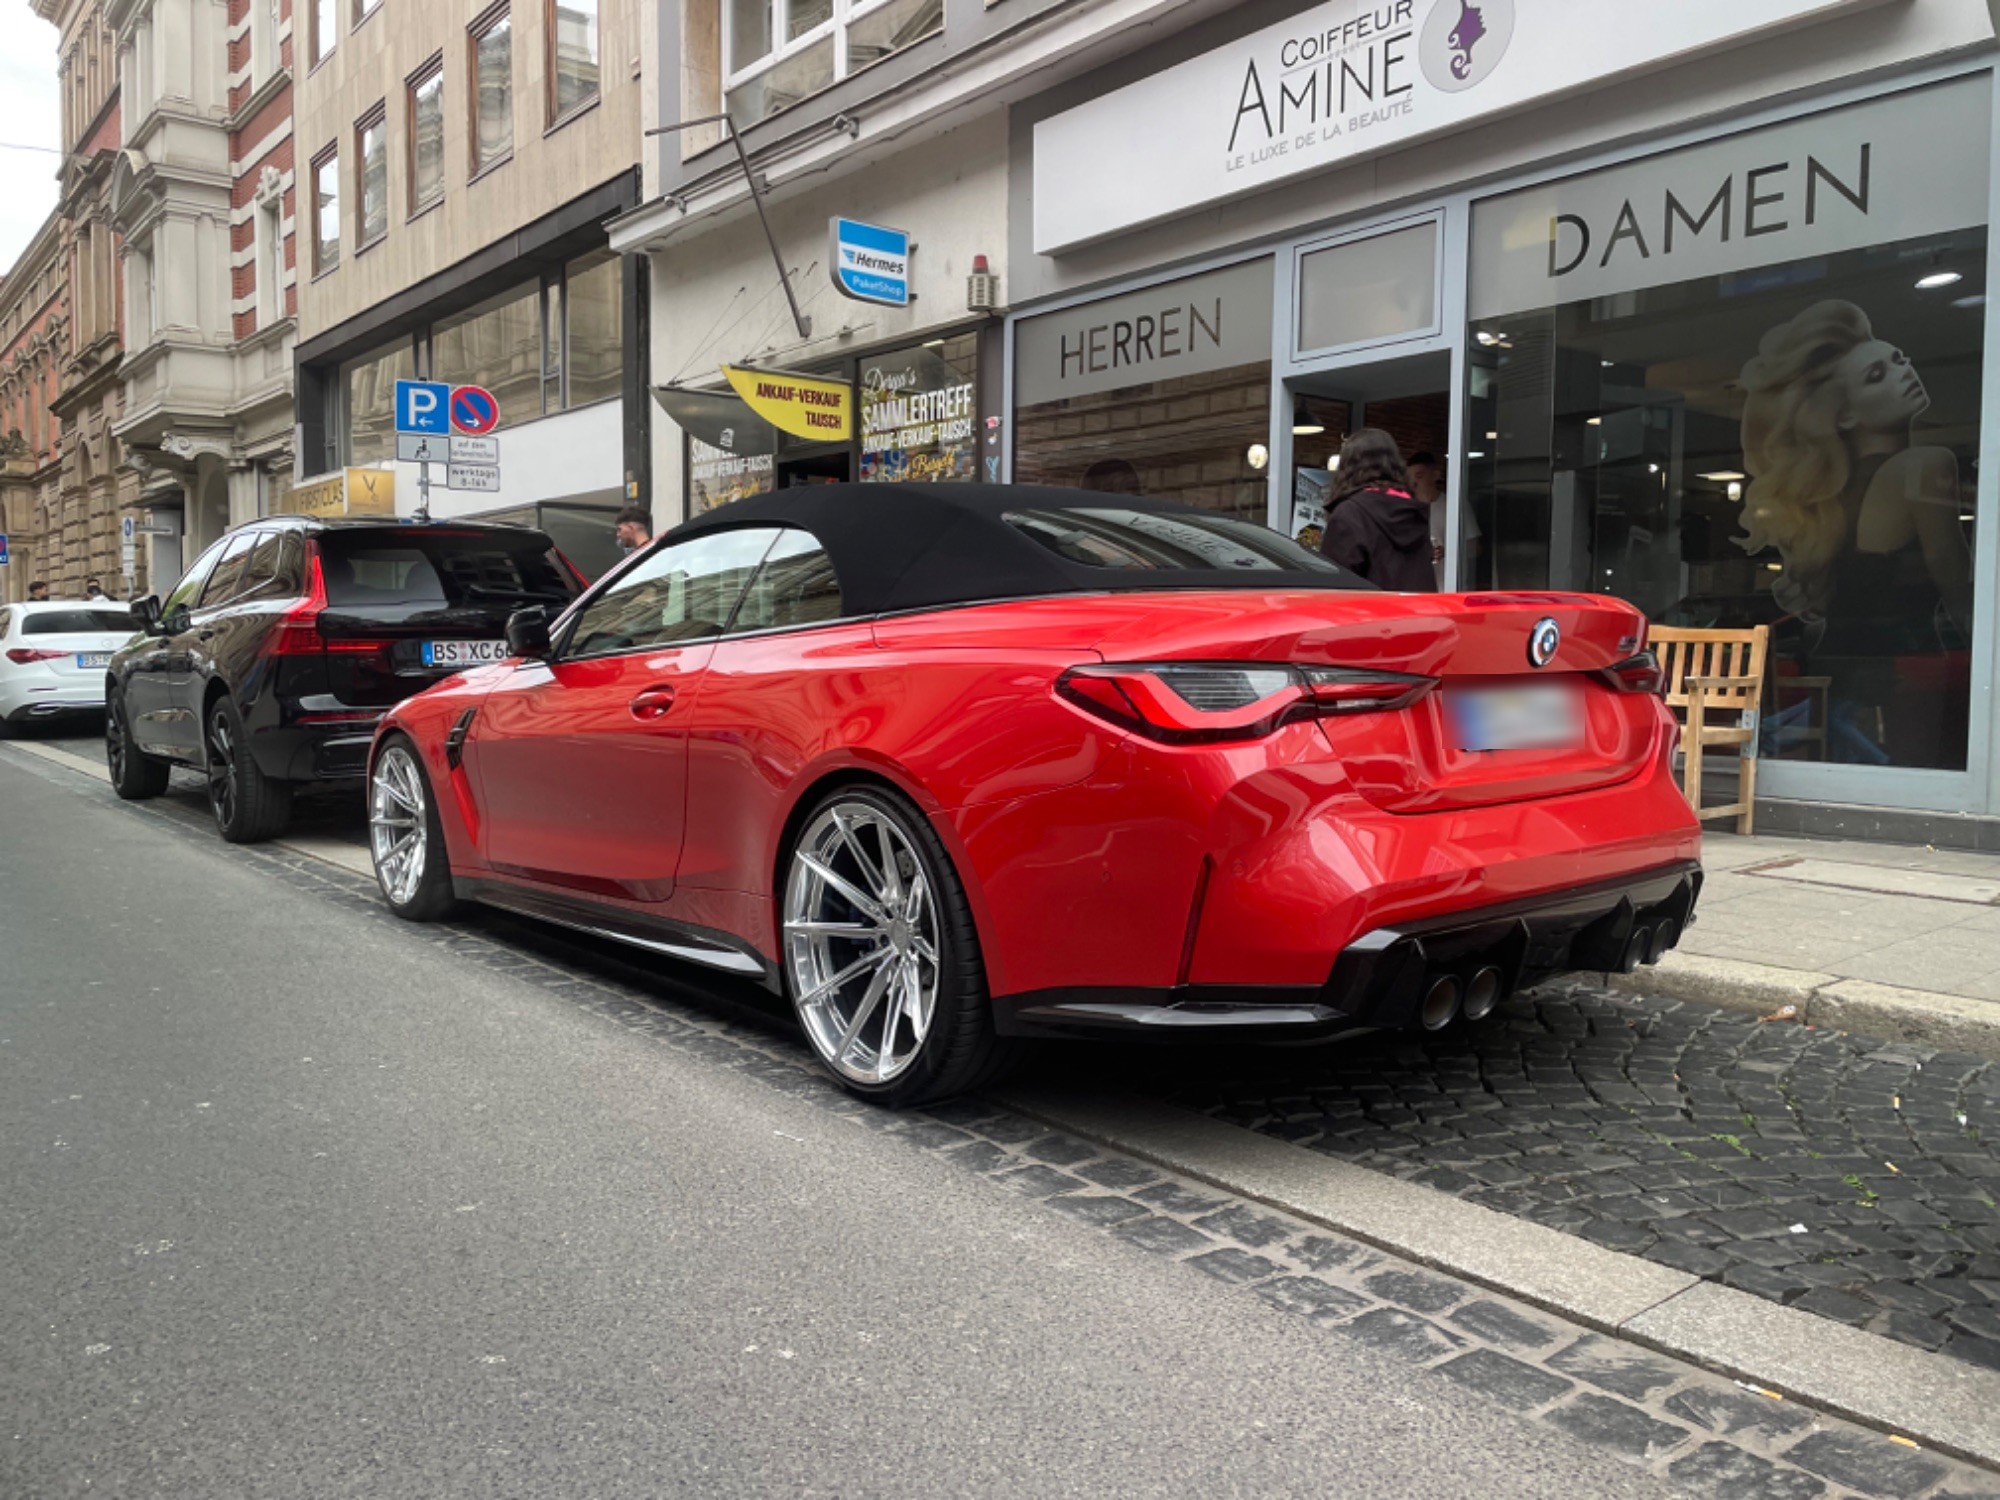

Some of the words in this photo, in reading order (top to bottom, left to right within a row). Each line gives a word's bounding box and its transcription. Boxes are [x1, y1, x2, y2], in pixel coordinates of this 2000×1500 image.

[1281, 0, 1412, 67] COIFFEUR
[1228, 31, 1413, 152] AMINE
[1226, 155, 1245, 172] LE
[1250, 140, 1289, 164] LUXE
[1295, 131, 1316, 150] DE
[1323, 123, 1342, 141] LA
[1348, 91, 1413, 132] BEAUTÉ
[1548, 142, 1871, 278] DAMEN
[856, 252, 904, 275] Hermes
[1061, 297, 1221, 379] HERREN
[408, 388, 438, 426] P
[756, 382, 842, 408] ANKAUF-VERKAUF
[805, 410, 842, 430] TAUSCH
[862, 383, 973, 433] SAMMLERTREFF
[434, 643, 457, 661] BS
[468, 642, 491, 660] XC
